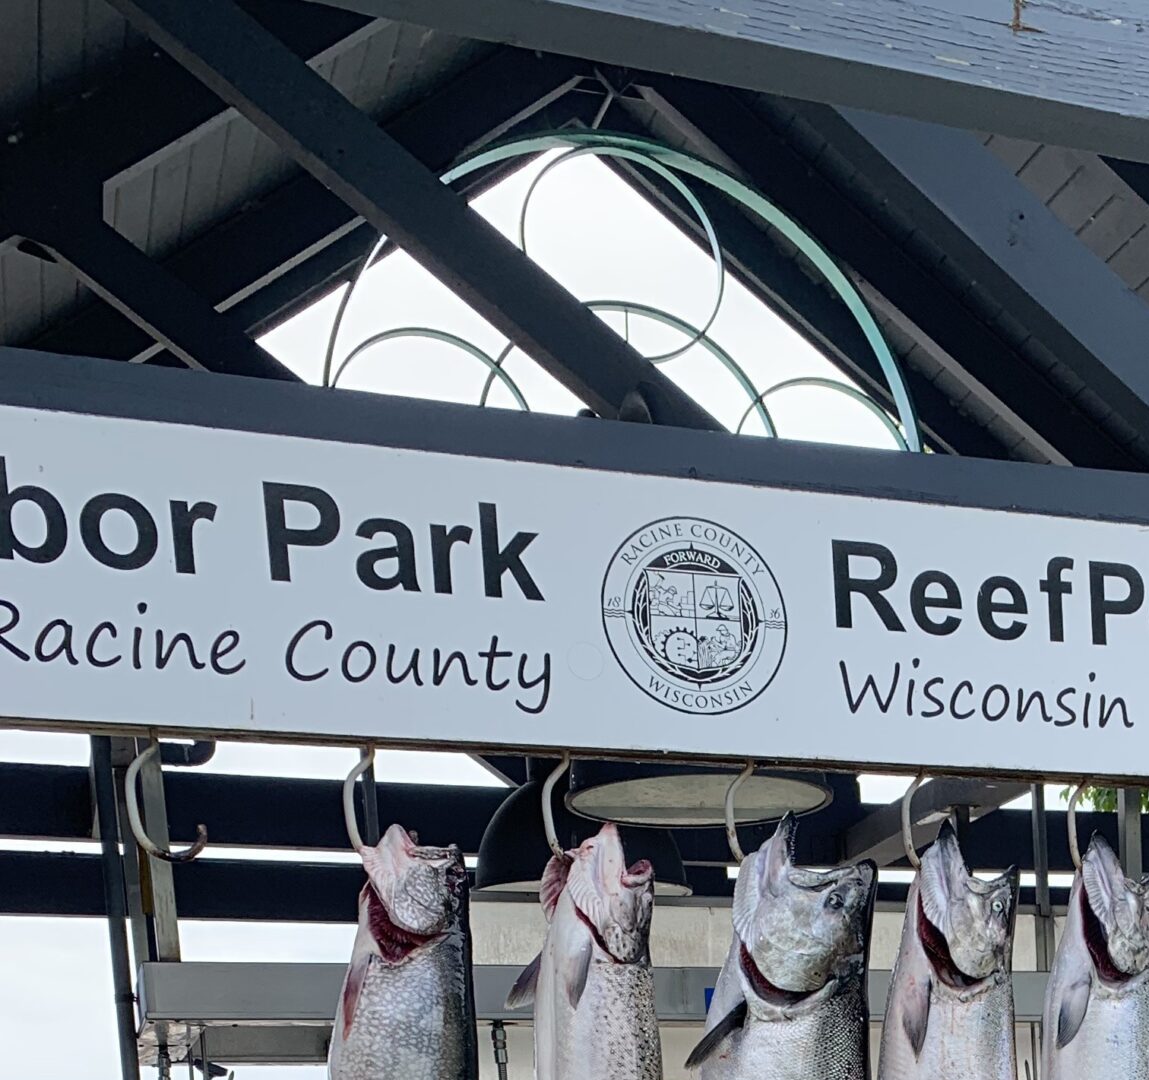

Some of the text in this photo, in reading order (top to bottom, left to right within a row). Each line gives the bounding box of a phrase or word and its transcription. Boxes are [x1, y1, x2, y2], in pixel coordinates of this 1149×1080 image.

[262, 470, 545, 602] Park
[621, 523, 765, 577] RACINE COUNTY
[663, 550, 721, 570] FORWARD
[0, 599, 552, 714] Racine County
[649, 675, 753, 709] WISCONSIN
[839, 660, 1135, 728] Wisconsin
